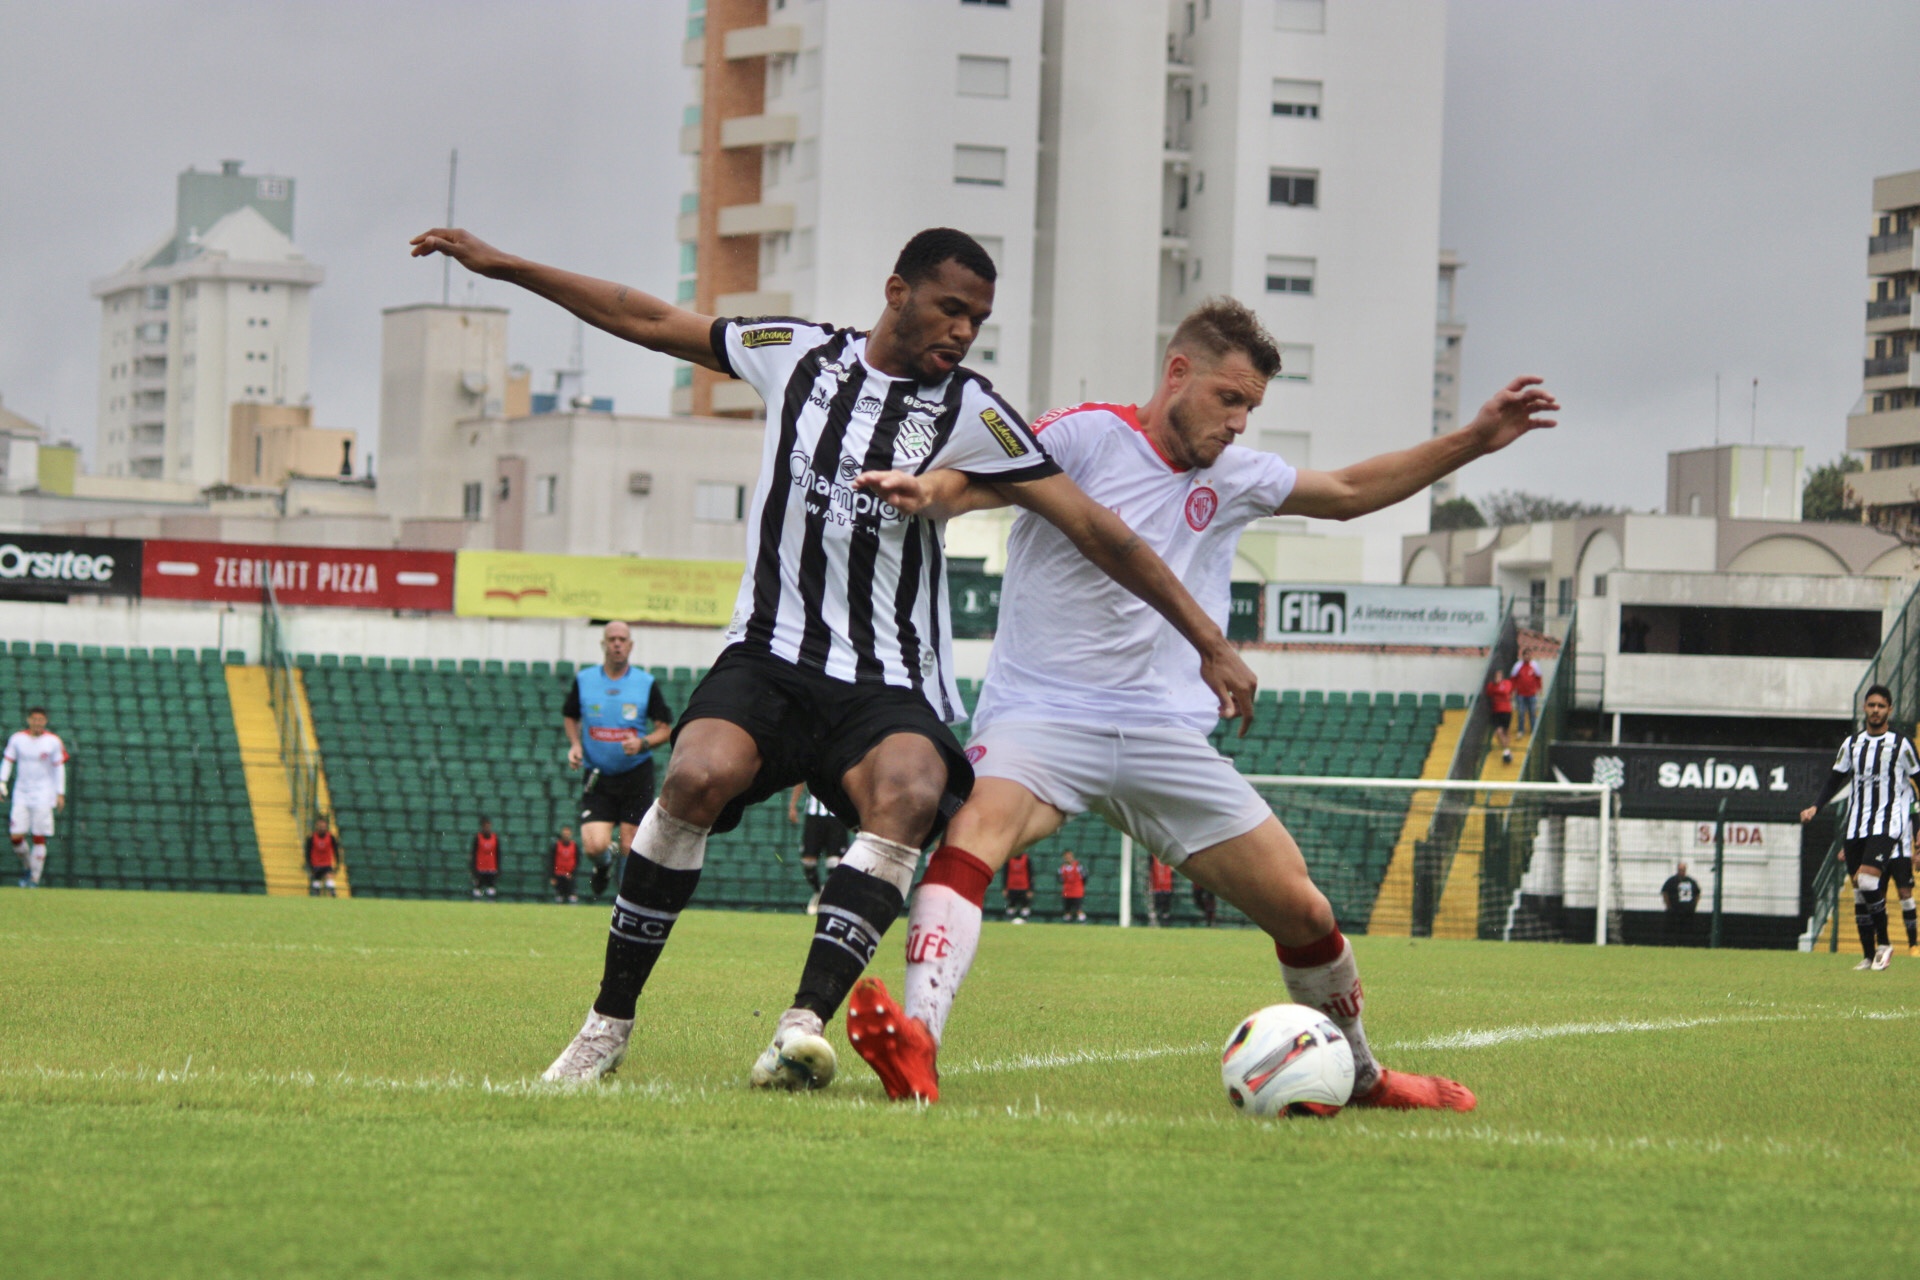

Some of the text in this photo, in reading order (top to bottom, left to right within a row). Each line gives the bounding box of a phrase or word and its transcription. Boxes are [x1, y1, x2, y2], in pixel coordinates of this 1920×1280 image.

[808, 394, 832, 412] VOLT
[0, 543, 116, 581] Orsitec
[317, 561, 379, 594] PIZZA
[1352, 605, 1364, 620] A
[1365, 604, 1427, 621] internet
[1658, 757, 1789, 791] SAÍDA 1
